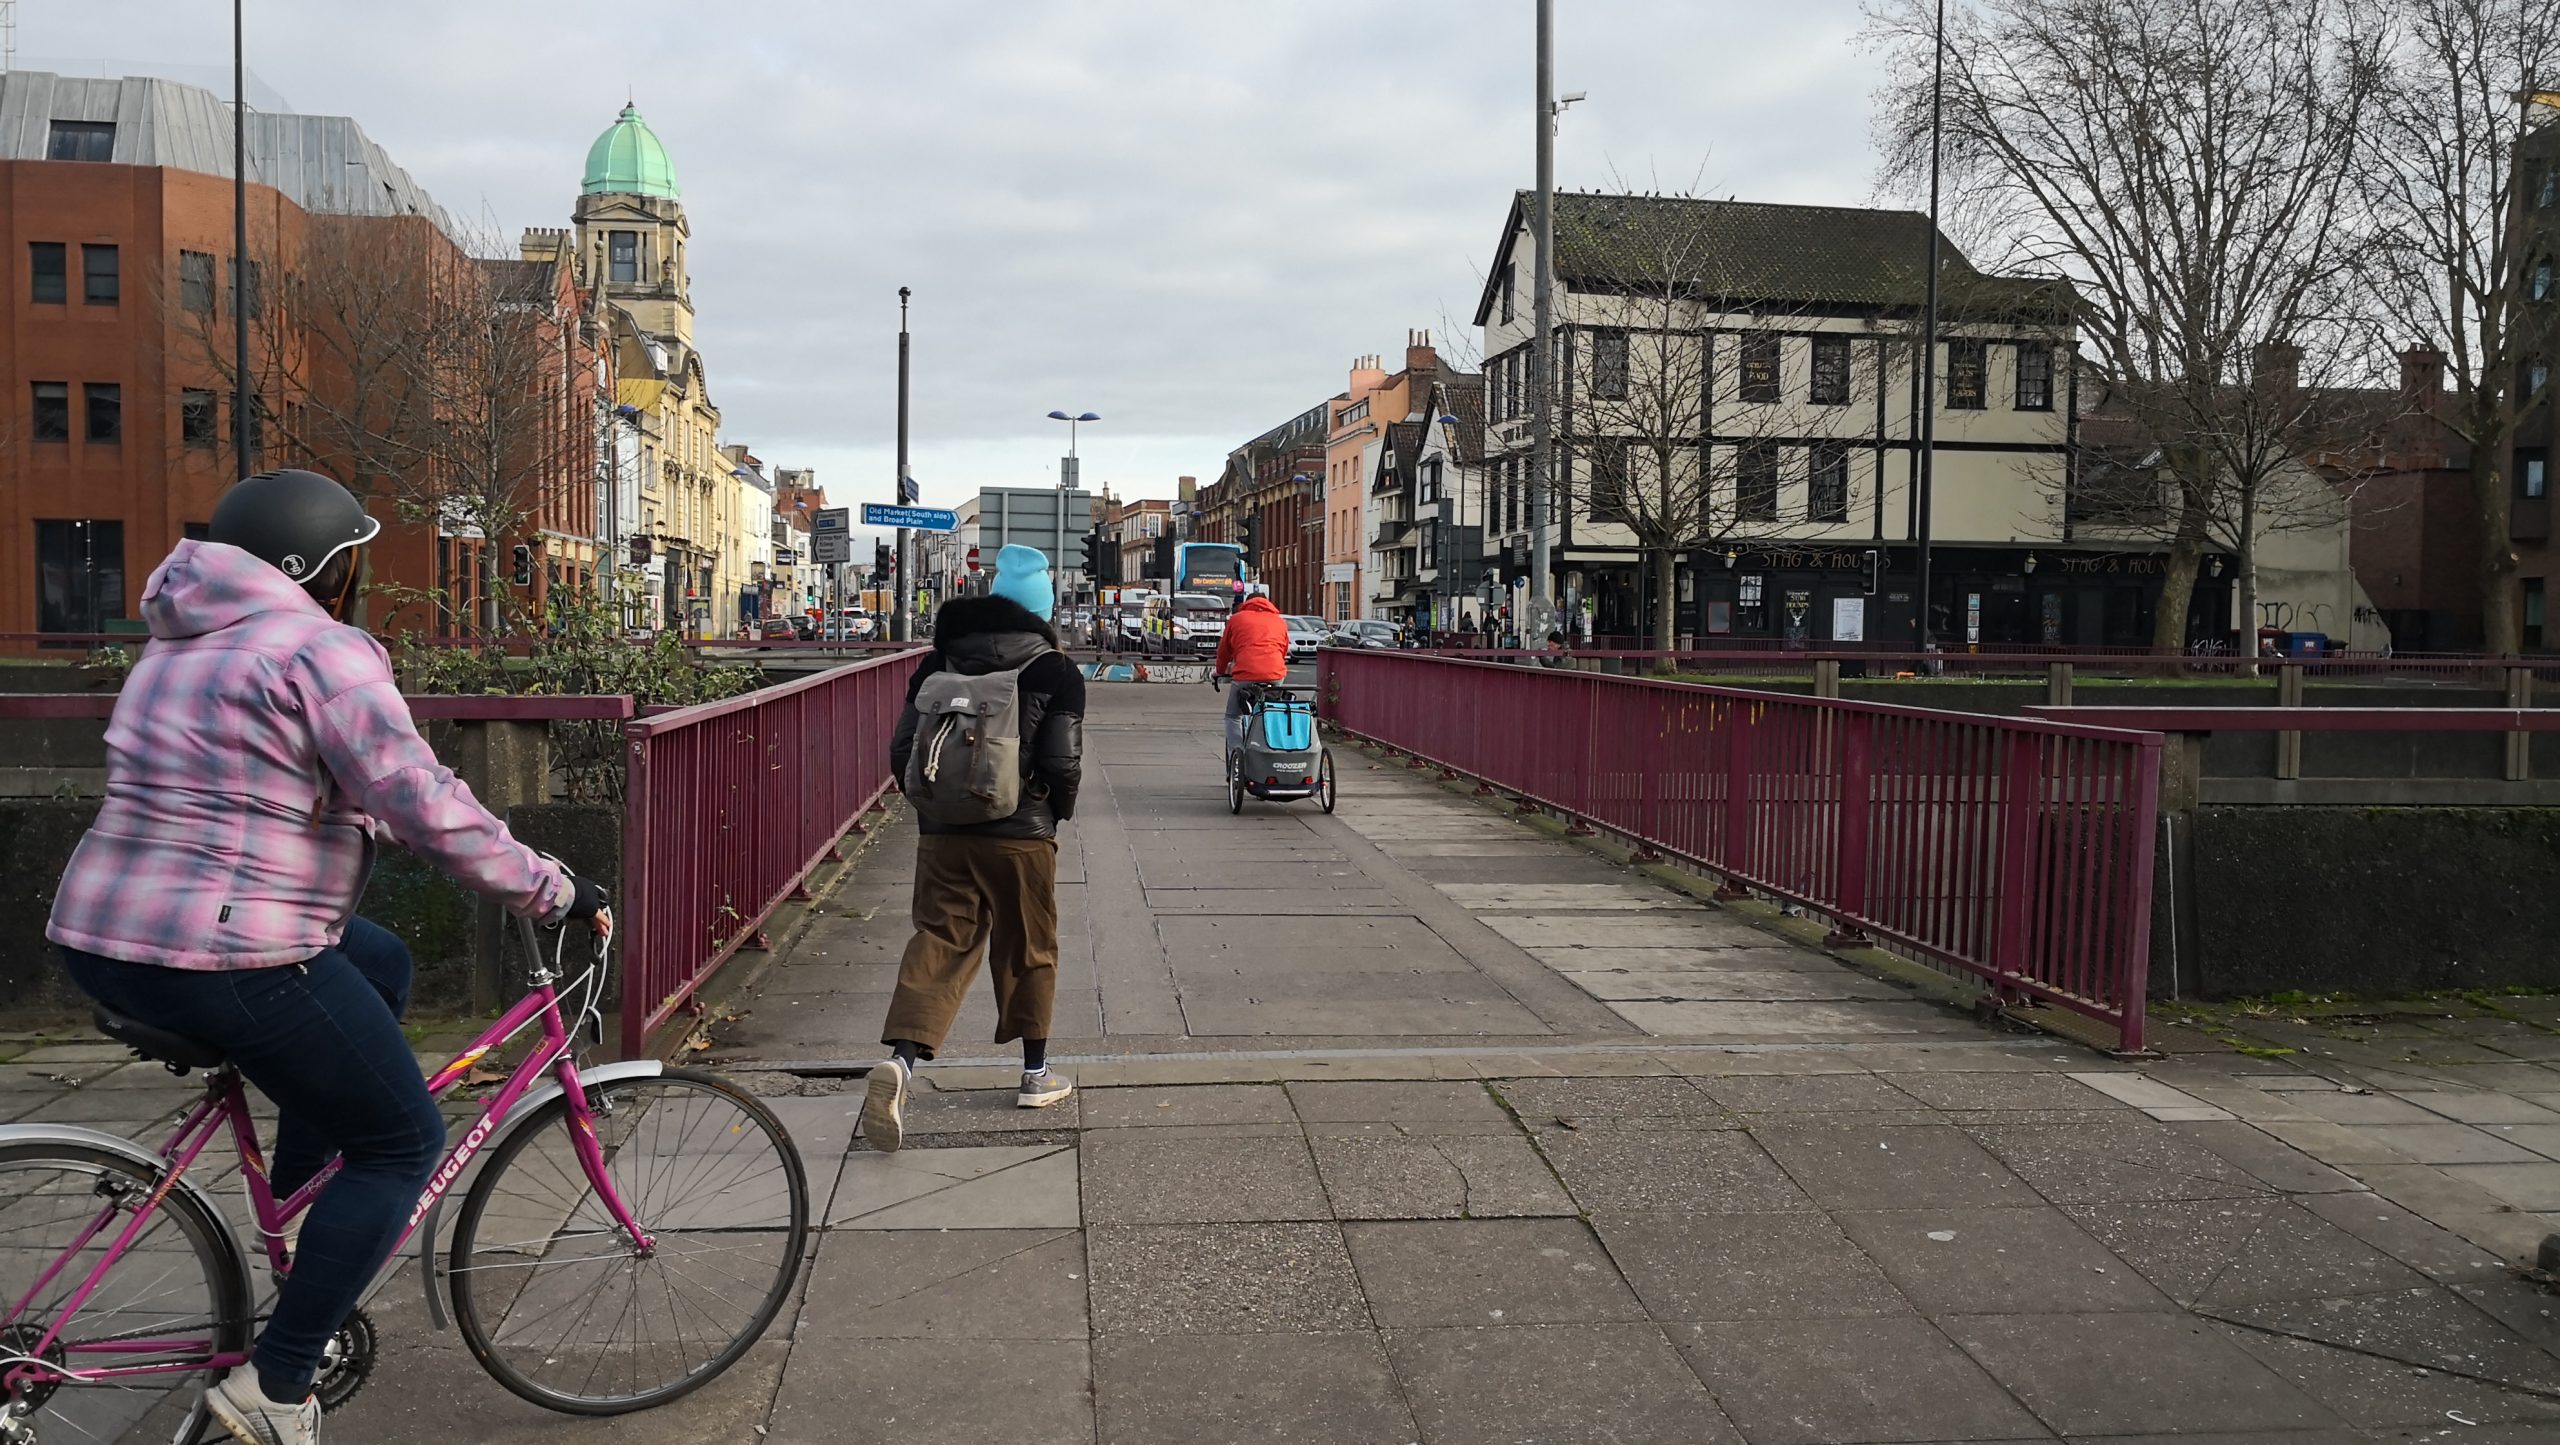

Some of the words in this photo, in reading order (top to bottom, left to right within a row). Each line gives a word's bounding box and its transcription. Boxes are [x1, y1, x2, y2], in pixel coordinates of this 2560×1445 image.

[906, 517, 923, 525] Plain
[933, 512, 951, 521] side)
[1760, 552, 1802, 568] STAG
[1808, 552, 1825, 568] &
[2061, 558, 2100, 573] STAG
[1272, 762, 1308, 770] CROOZER
[408, 1112, 495, 1227] PEUGEOT
